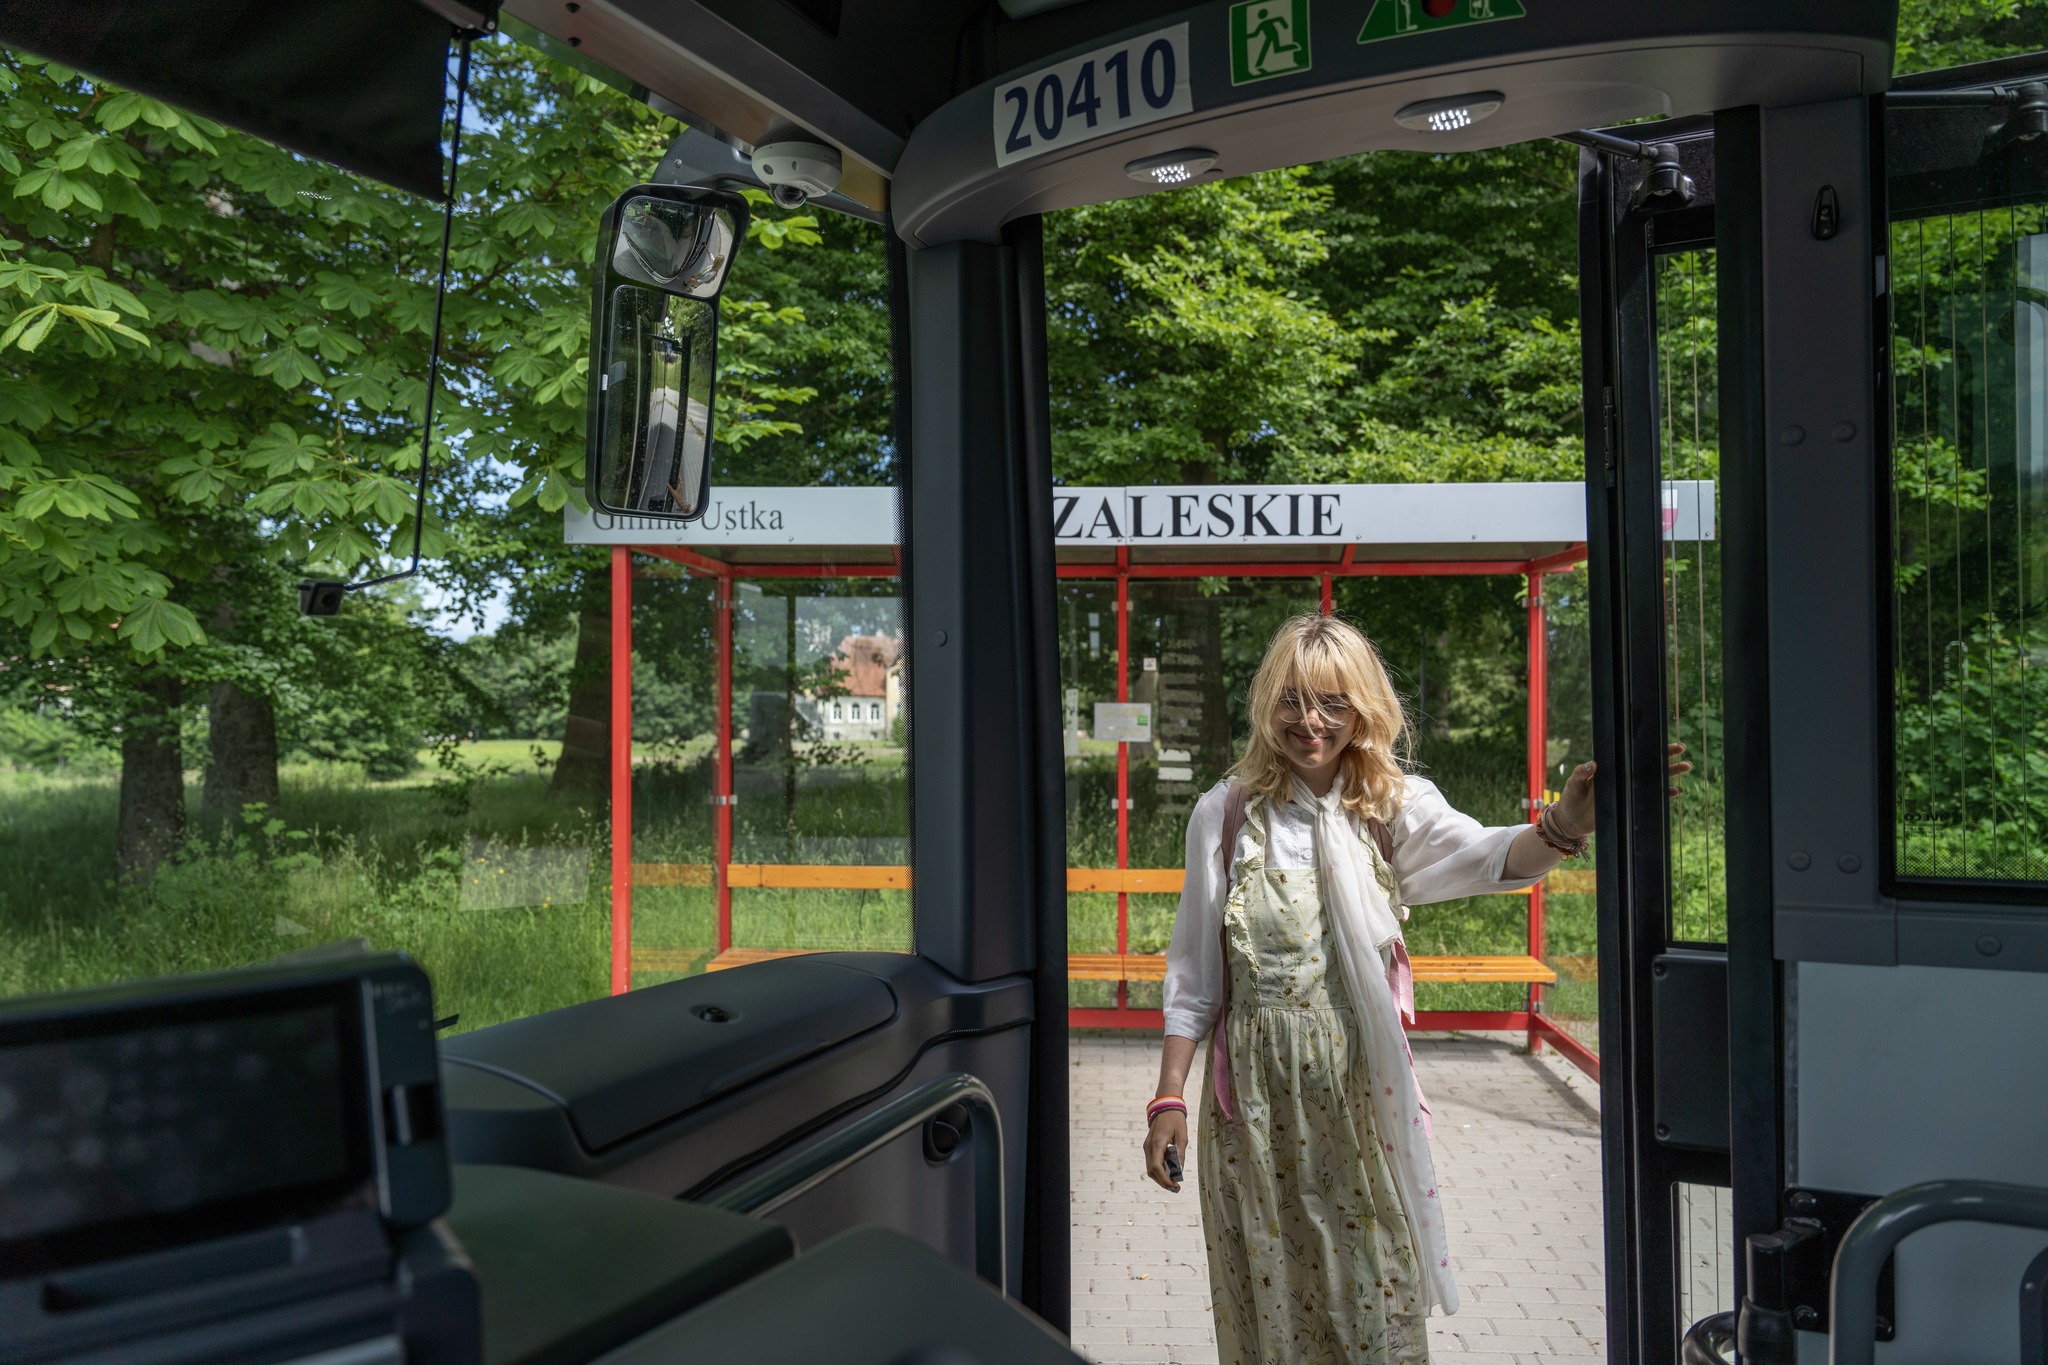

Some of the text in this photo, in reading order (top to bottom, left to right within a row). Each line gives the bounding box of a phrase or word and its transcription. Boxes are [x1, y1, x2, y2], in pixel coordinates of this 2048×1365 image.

[1004, 38, 1176, 155] 20410
[702, 500, 784, 531] Ustka
[1053, 493, 1343, 538] ZALESKIE
